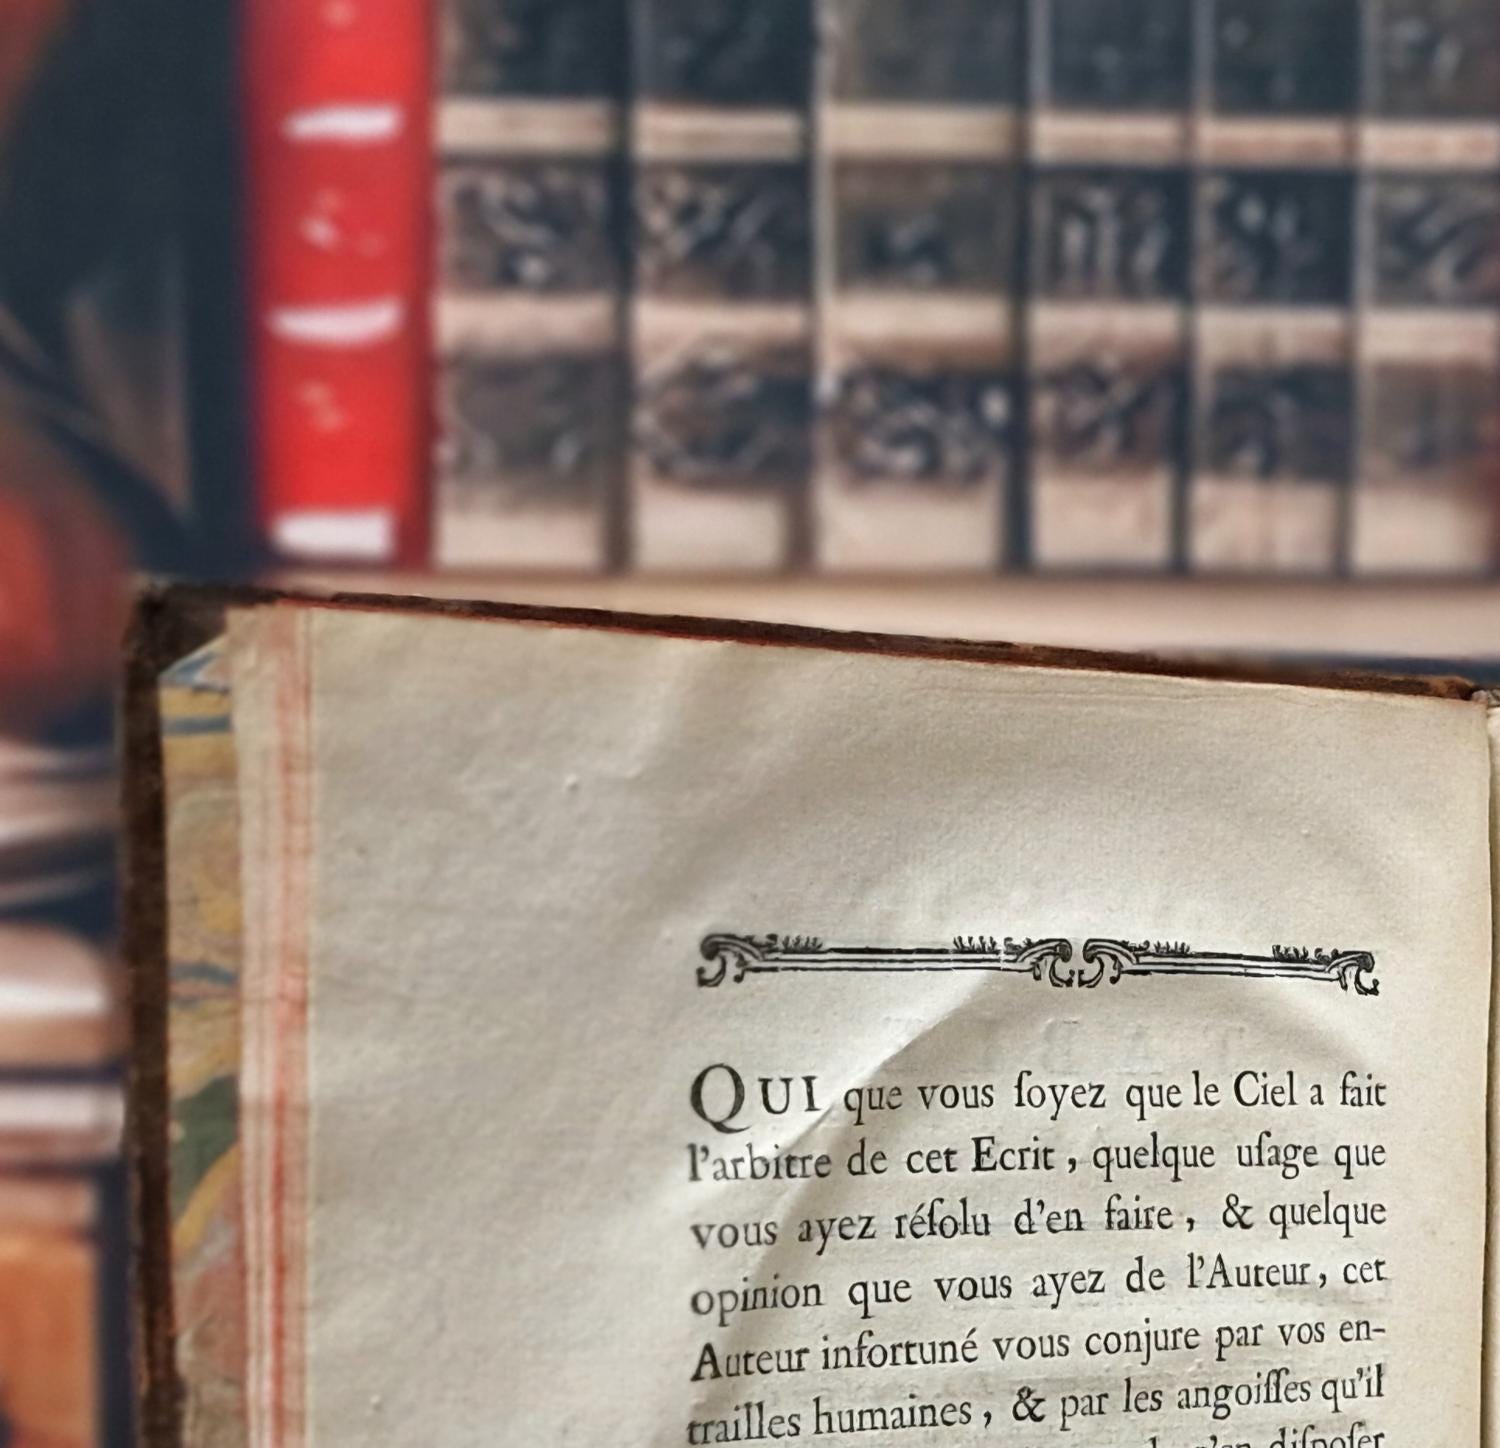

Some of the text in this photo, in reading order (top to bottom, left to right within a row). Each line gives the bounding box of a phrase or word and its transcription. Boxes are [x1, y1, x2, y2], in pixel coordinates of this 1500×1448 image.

[689, 1062, 823, 1135] QUI
[843, 1082, 903, 1127] que
[916, 1084, 994, 1110] vous
[1125, 1084, 1183, 1122] que
[1191, 1069, 1221, 1107] le
[1233, 1069, 1298, 1108] Ciel
[1310, 1083, 1325, 1106] a
[1339, 1069, 1387, 1108] fait
[686, 1142, 833, 1182] l'arbitre
[846, 1136, 888, 1177] de
[905, 1147, 958, 1174] cet
[1092, 1130, 1216, 1183] quelque
[1334, 1144, 1386, 1181] que
[689, 1221, 778, 1250] vous
[797, 1214, 877, 1257] ayez
[1014, 1197, 1086, 1236] d'en
[1222, 1193, 1255, 1230] &
[1269, 1189, 1387, 1240] quelque
[690, 1272, 825, 1328] opinion
[847, 1279, 913, 1320] que
[933, 1275, 1013, 1302] vous
[1032, 1269, 1106, 1310] ayez
[1125, 1255, 1166, 1294] de
[1342, 1258, 1389, 1285] cet
[689, 1317, 1386, 1383] Auteur infortuné vous conjure par vos en-
[686, 1400, 801, 1446] trailles
[1012, 1385, 1047, 1423] &
[1059, 1392, 1110, 1432] par
[1122, 1376, 1163, 1414] les
[1321, 1362, 1385, 1414] qu'il
